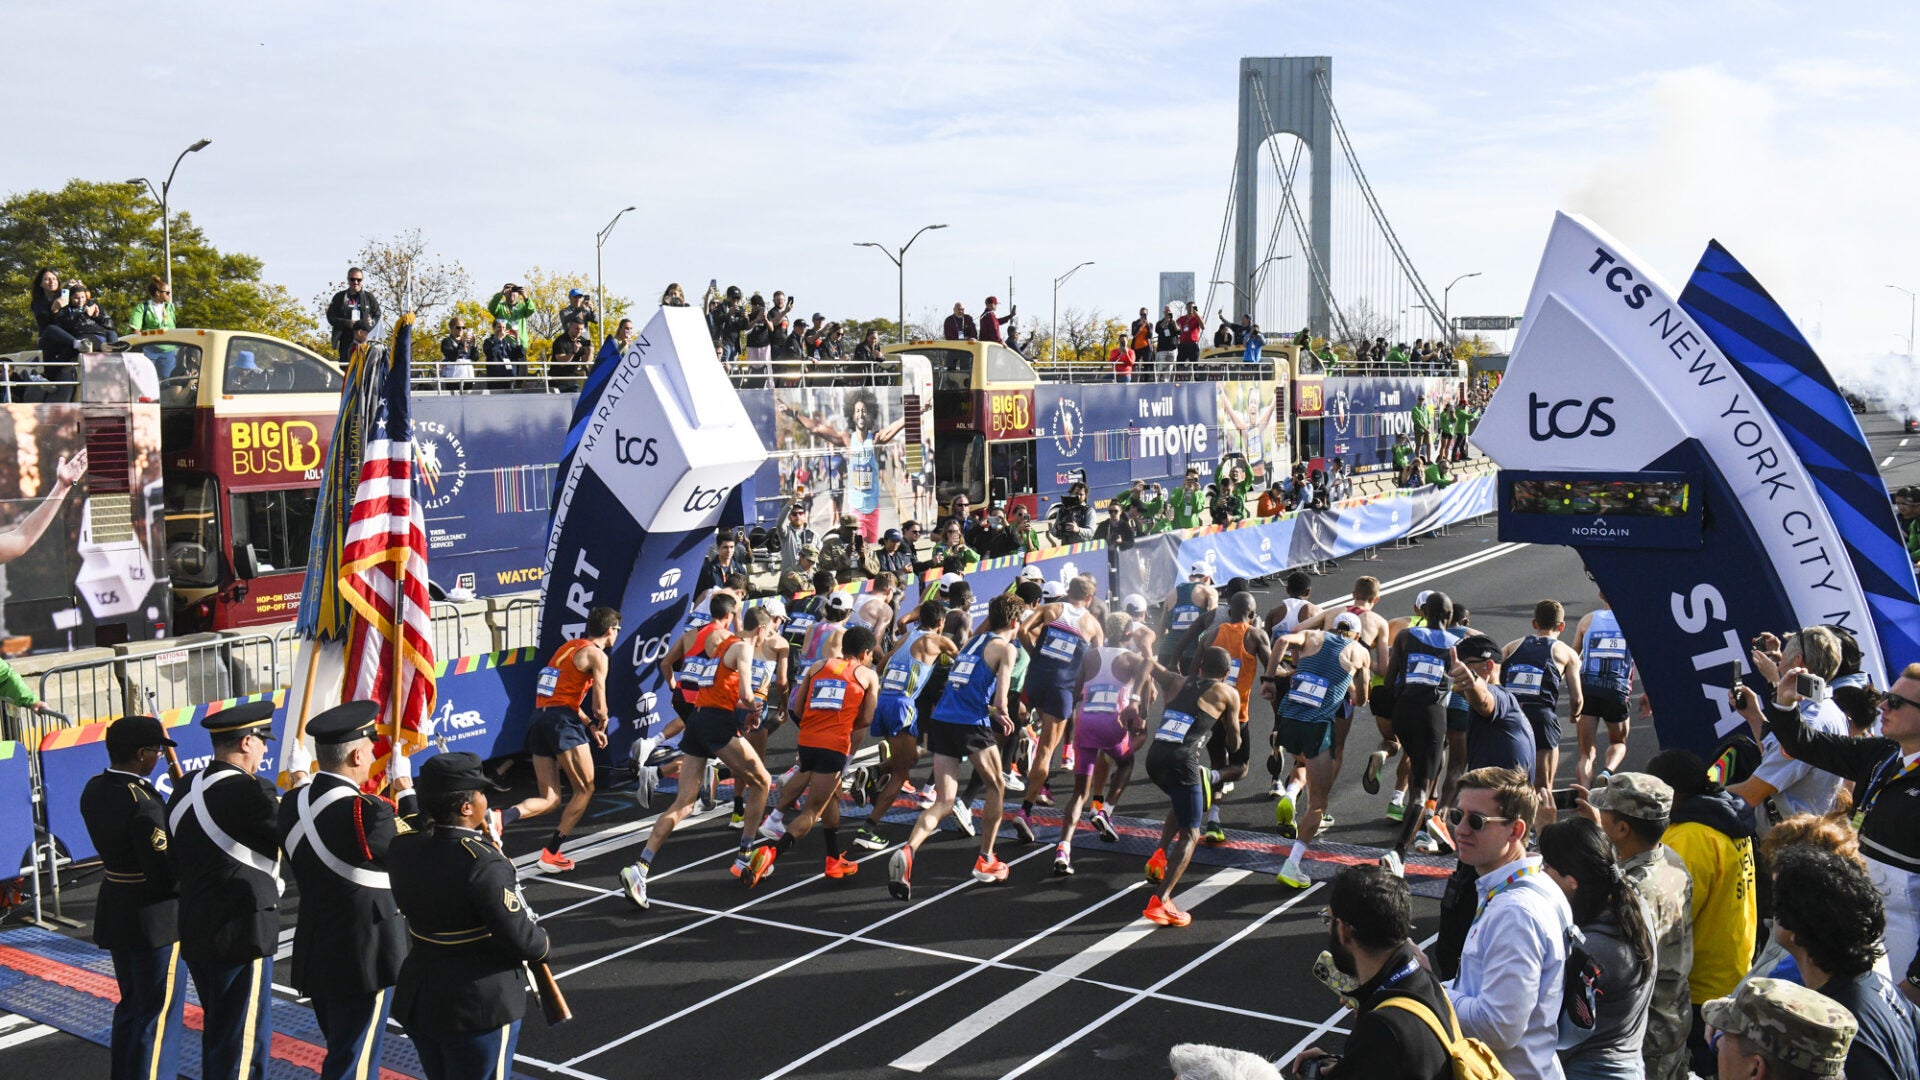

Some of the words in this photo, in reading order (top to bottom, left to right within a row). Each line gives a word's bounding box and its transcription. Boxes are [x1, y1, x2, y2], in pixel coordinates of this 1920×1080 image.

[992, 395, 1013, 414] BIG
[1139, 398, 1149, 418] It
[1151, 396, 1173, 417] will
[1387, 389, 1400, 406] will
[562, 456, 587, 509] CITY
[583, 333, 652, 452] MARATHON
[993, 414, 1014, 431] BUS
[1529, 391, 1616, 442] tcs
[1588, 247, 1653, 310] TCS
[1649, 308, 1727, 387] NEW
[1720, 394, 1795, 500] YORK
[1782, 510, 1842, 592] CITY
[231, 421, 281, 449] BIG
[419, 421, 446, 435] TCS
[446, 431, 465, 458] NEW
[615, 428, 659, 467] tcs
[1140, 422, 1208, 458] move
[232, 448, 283, 475] BUS
[450, 461, 467, 496] YORK
[424, 494, 450, 510] CITY
[683, 484, 729, 512] tcs
[429, 532, 467, 543] CONSULTANCY
[1571, 527, 1630, 537] NORQAIN
[430, 541, 454, 549] SERVICES
[560, 547, 600, 642] ART
[650, 587, 679, 604] TATA
[632, 632, 672, 667] tcs
[1609, 639, 1618, 649] 26
[1670, 582, 1765, 739] STA
[1524, 674, 1534, 684] 30
[828, 688, 837, 698] 34
[632, 711, 662, 731] TATA
[1171, 721, 1182, 732] 37
[457, 727, 488, 741] RUNNERS
